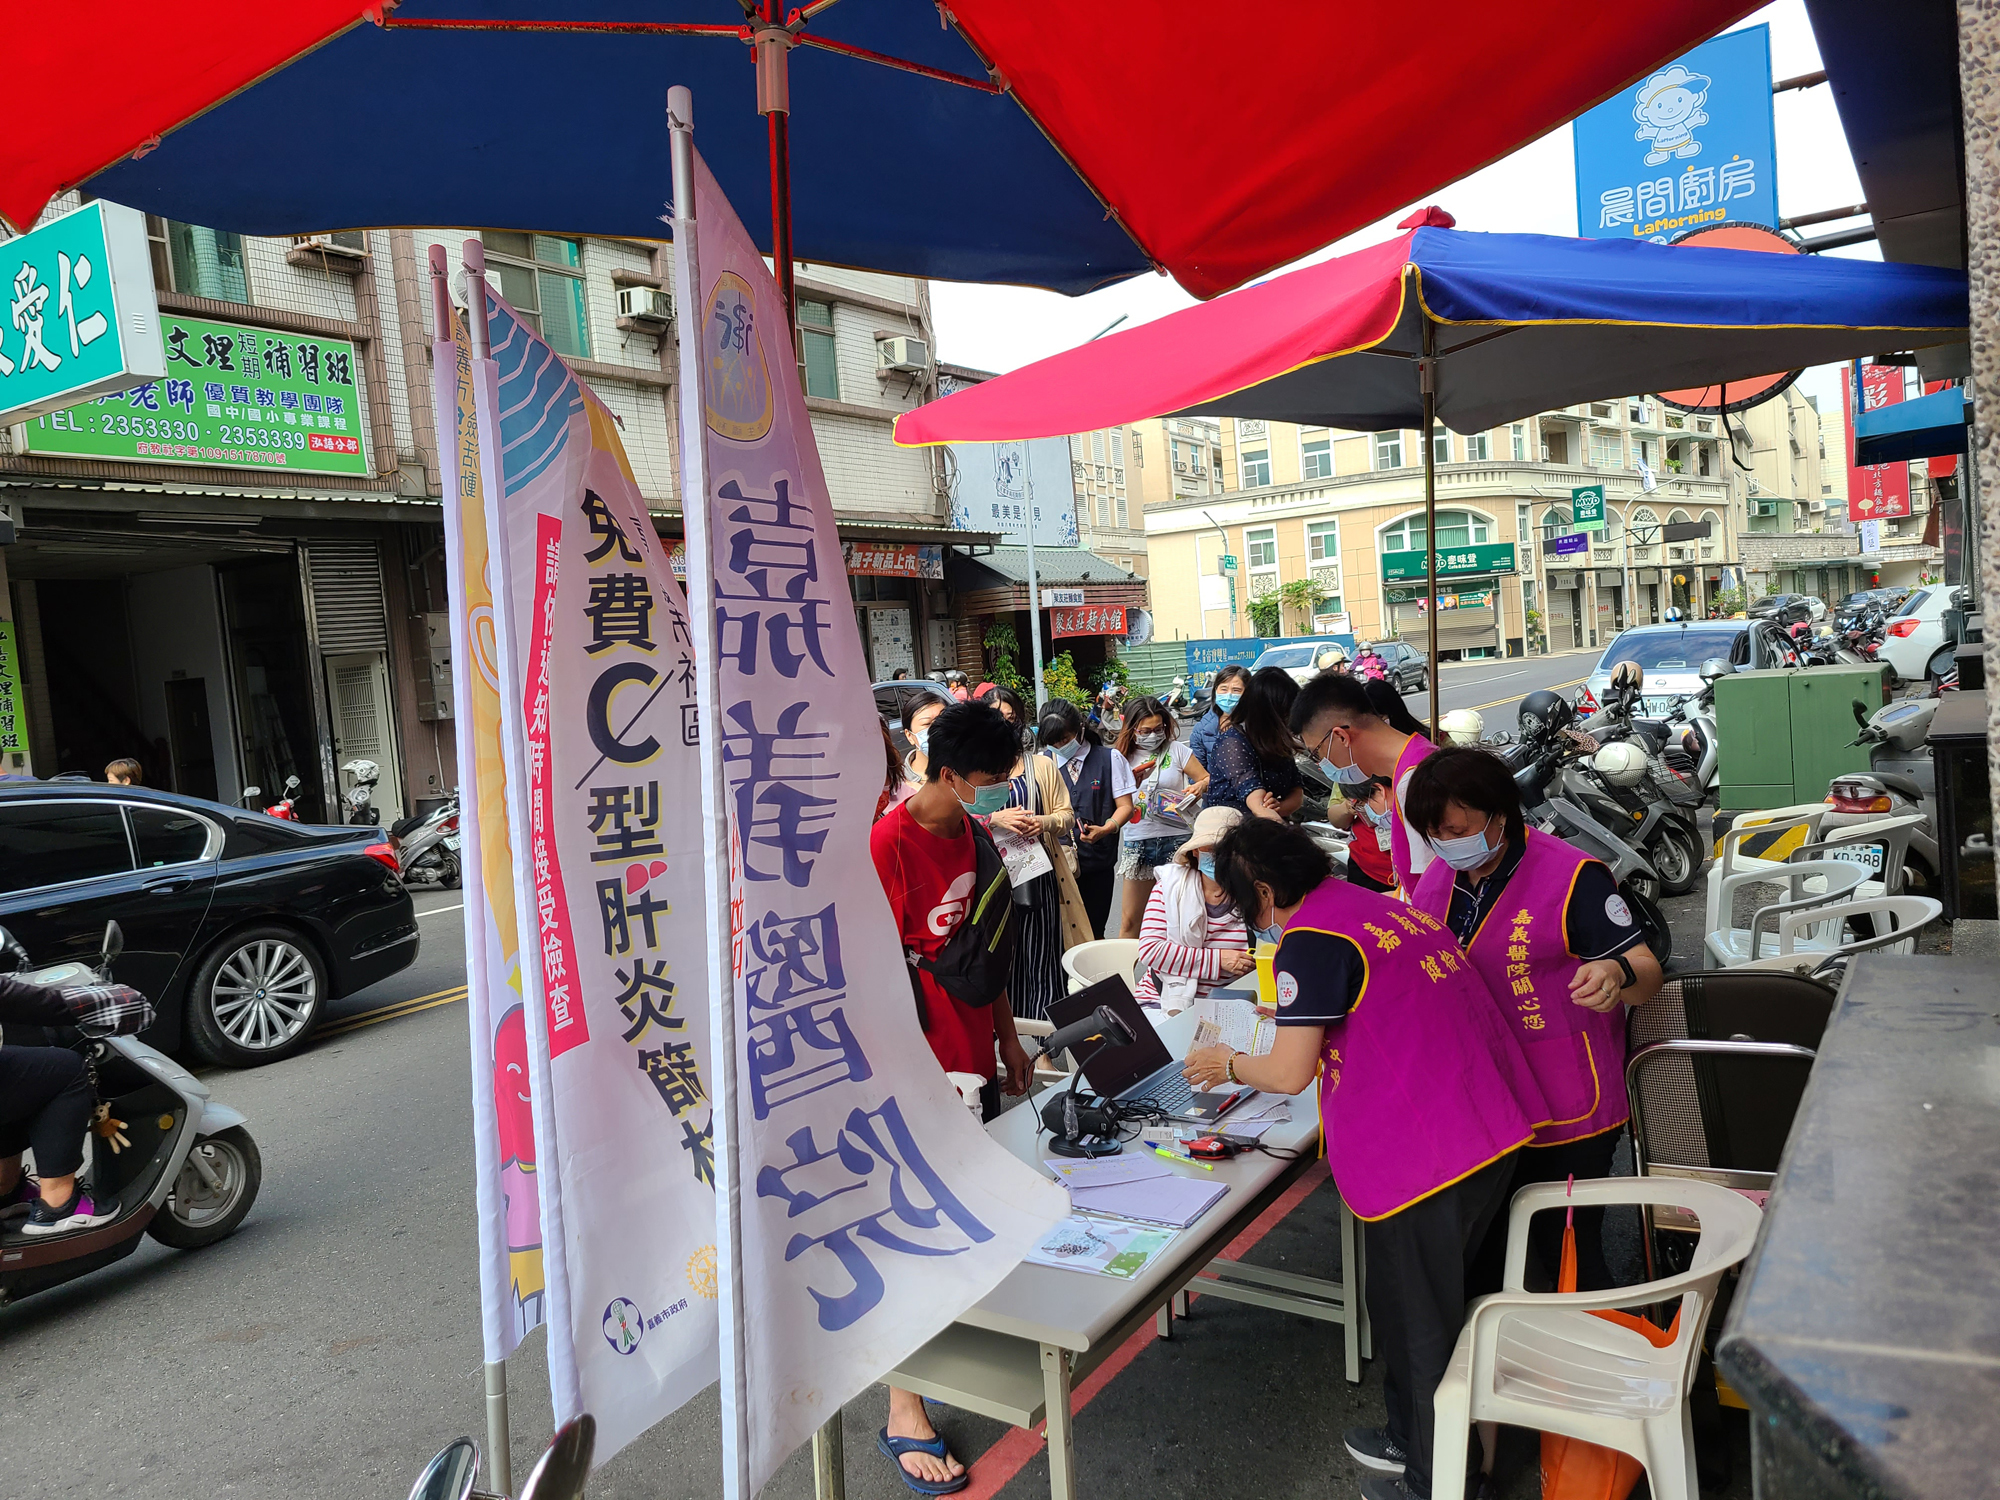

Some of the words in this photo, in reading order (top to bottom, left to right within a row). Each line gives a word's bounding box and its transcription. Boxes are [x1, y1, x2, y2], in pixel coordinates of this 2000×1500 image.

[1599, 155, 1756, 228] 晨間廚房
[1633, 207, 1726, 236] LaMorning
[89, 379, 195, 415] 老師
[205, 381, 345, 415] 優質教學團隊
[101, 414, 199, 442] 2353330
[219, 425, 305, 450] 2353339
[991, 503, 1042, 522] 最美是見
[1362, 906, 1446, 954] 嘉義醫
[1506, 908, 1546, 1031] 嘉義醫院關心您
[646, 1297, 689, 1332] 嘉義市政府
